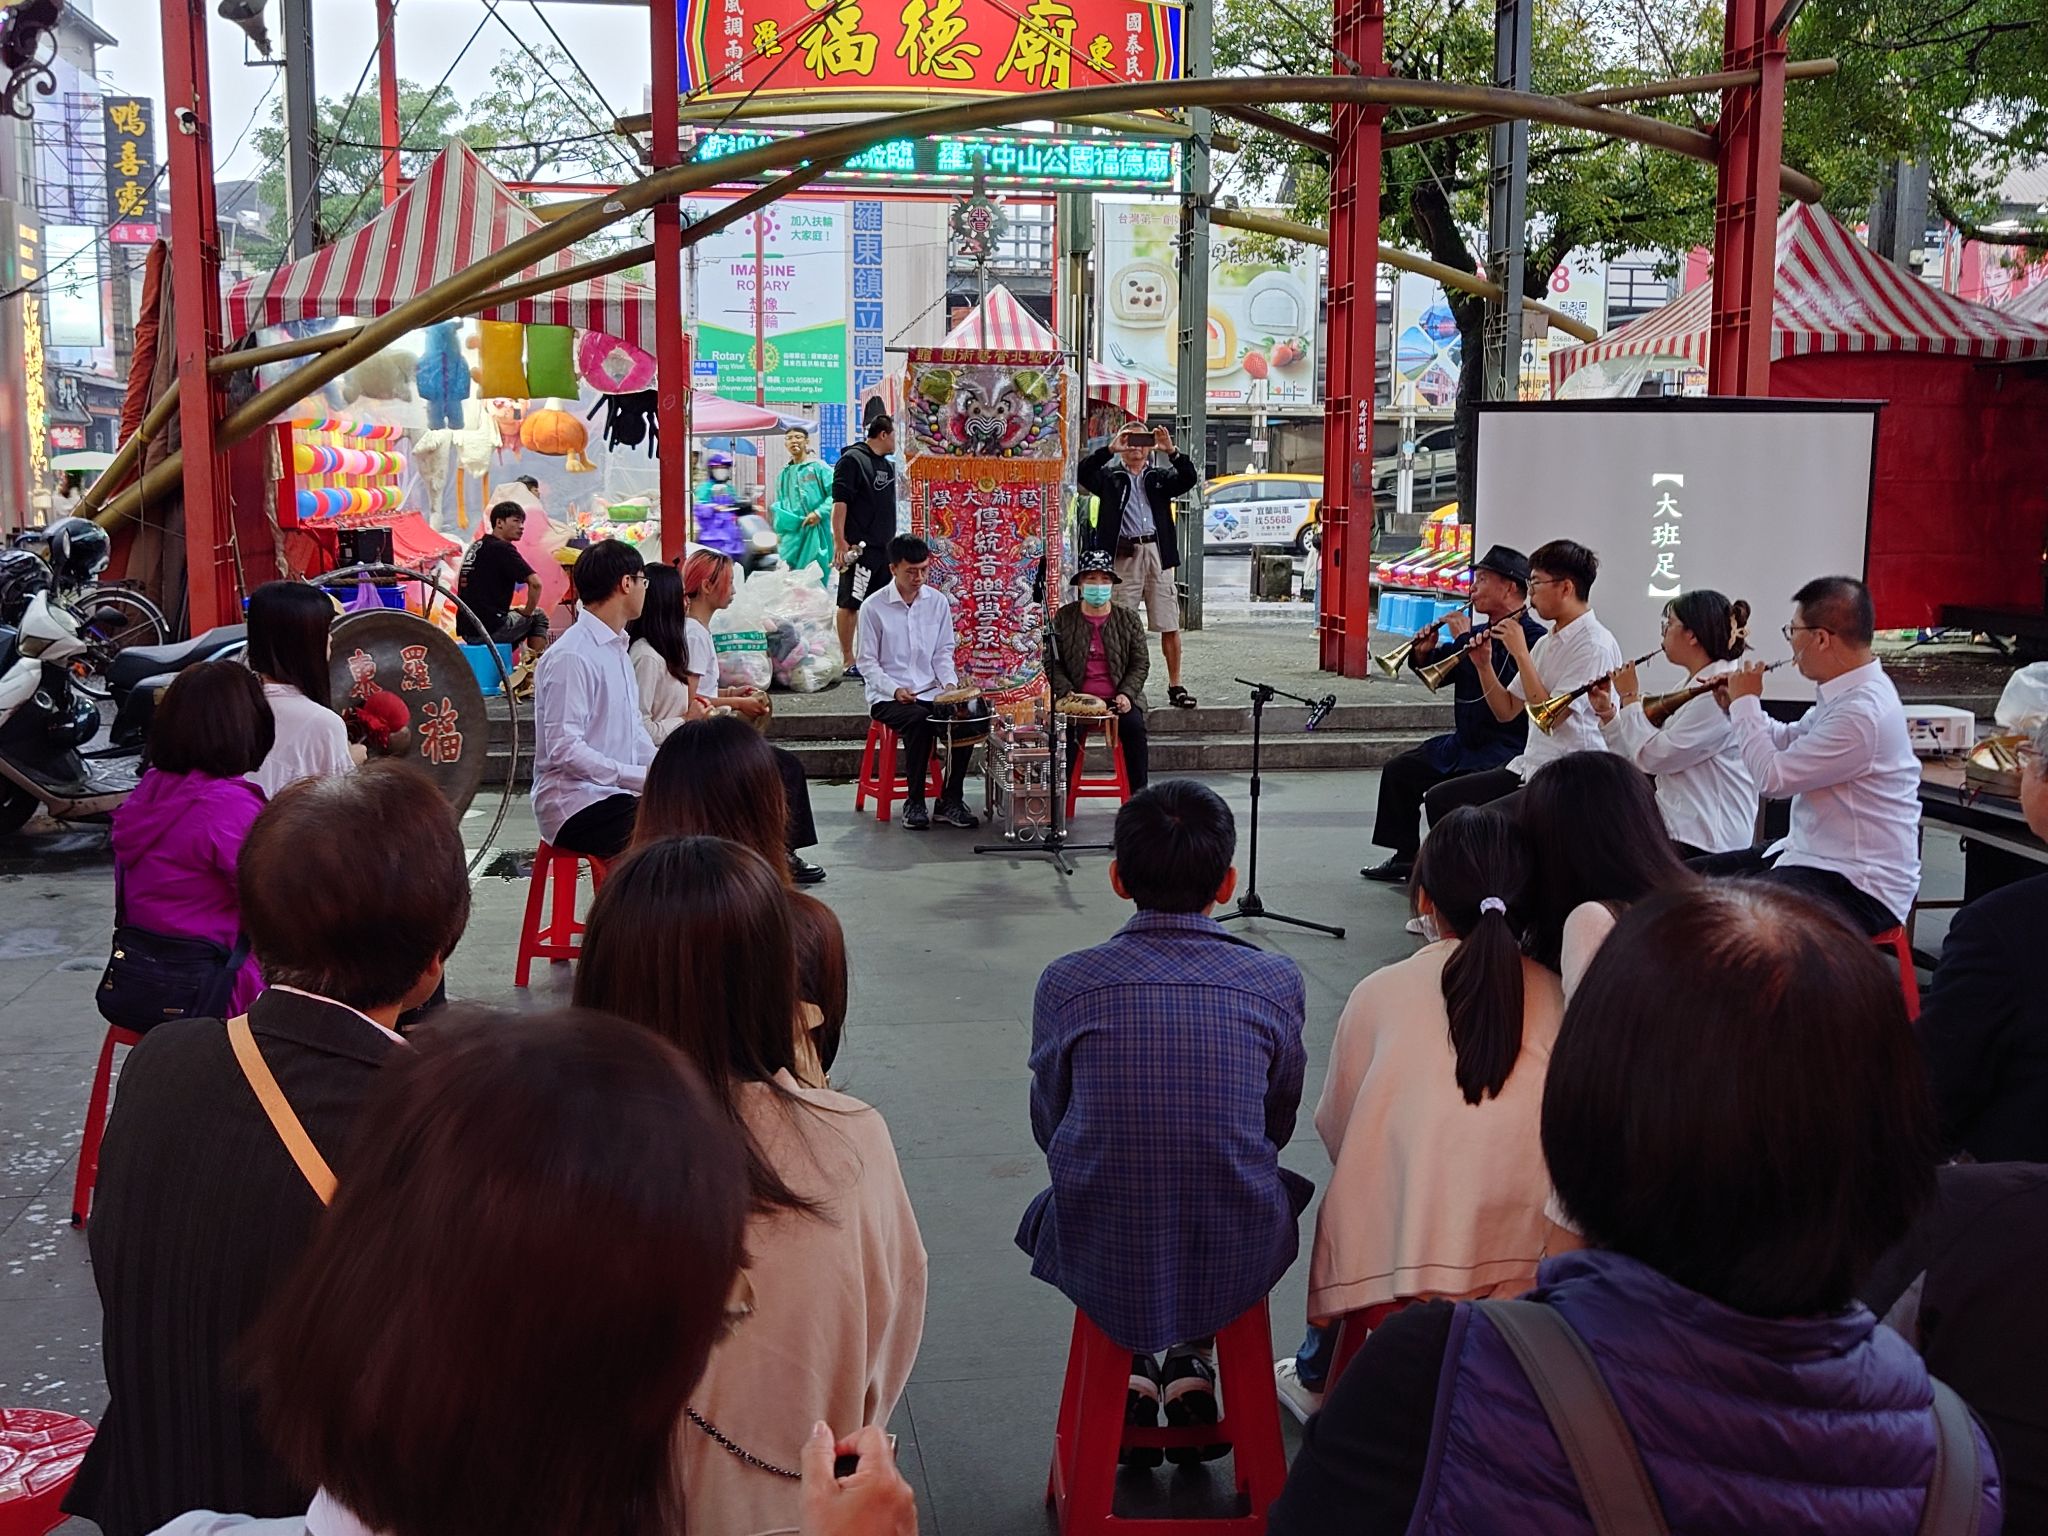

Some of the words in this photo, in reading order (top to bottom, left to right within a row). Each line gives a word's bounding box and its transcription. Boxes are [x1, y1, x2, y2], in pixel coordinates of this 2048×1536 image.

[1125, 13, 1144, 84] 國泰民
[791, 216, 832, 227] 加入扶輪
[737, 280, 790, 292] ROARY
[712, 351, 745, 363] Rotary
[851, 563, 872, 601] NIKE
[973, 507, 1003, 649] 傳統音樂學系
